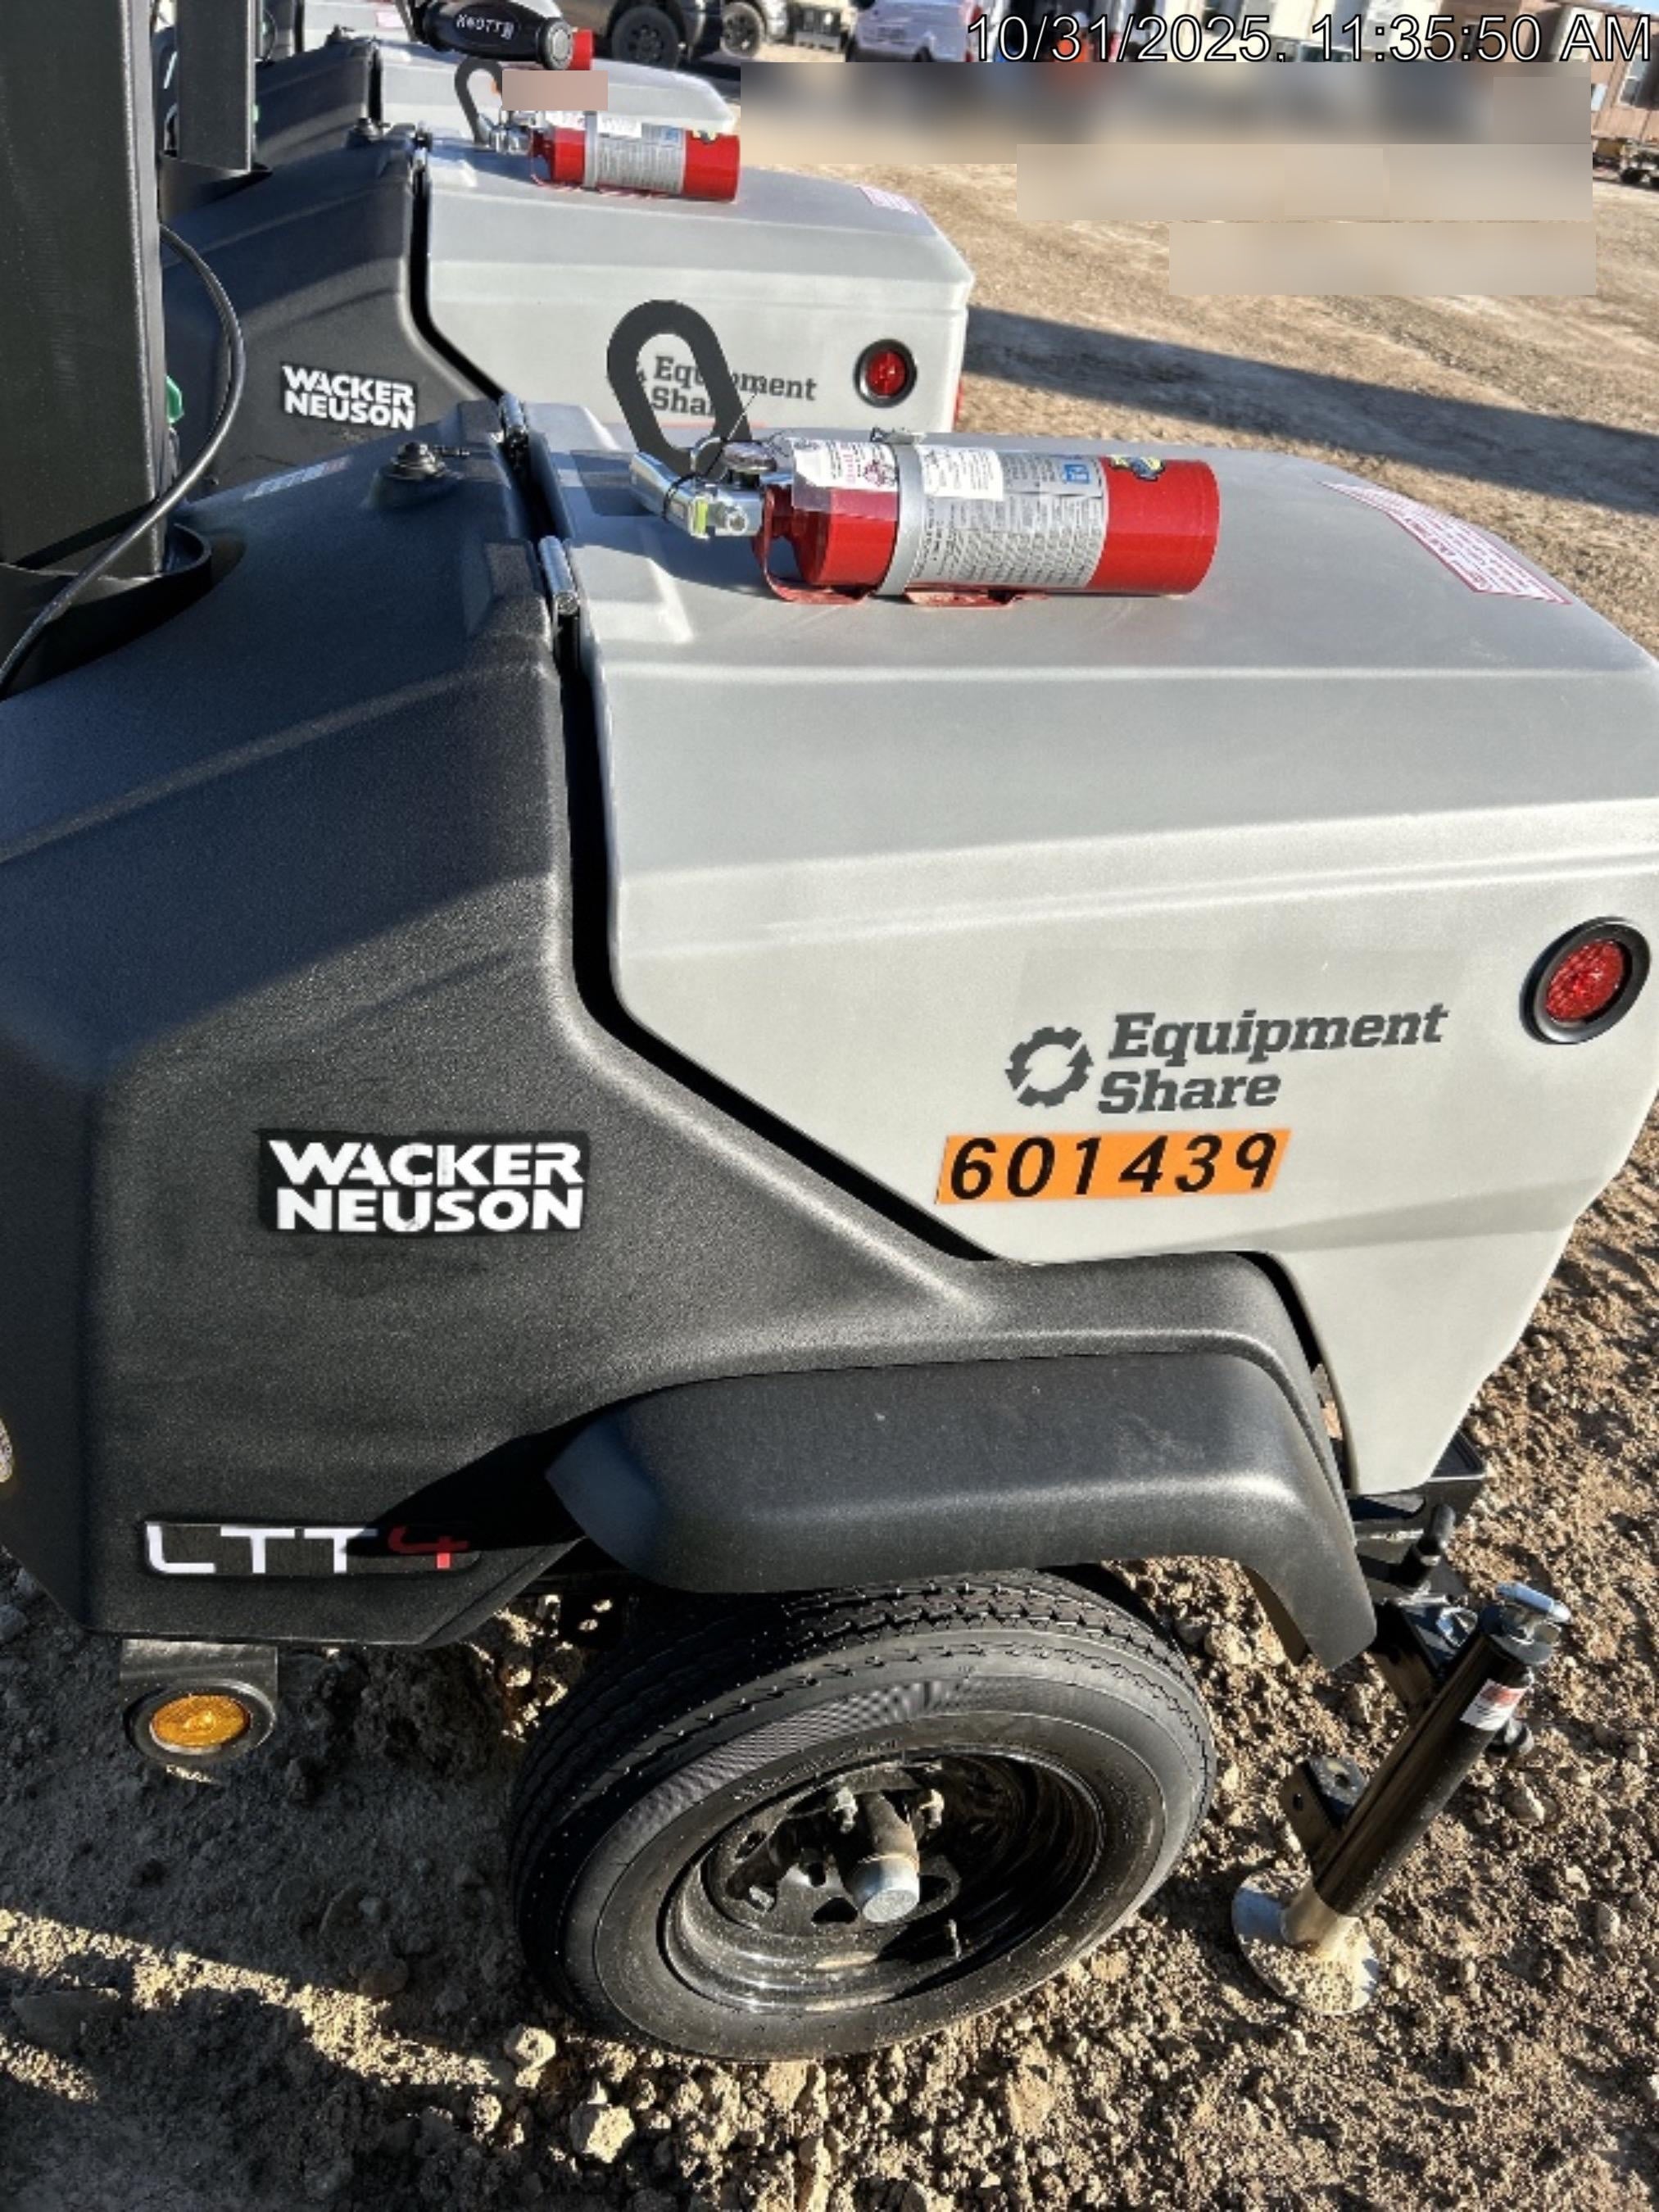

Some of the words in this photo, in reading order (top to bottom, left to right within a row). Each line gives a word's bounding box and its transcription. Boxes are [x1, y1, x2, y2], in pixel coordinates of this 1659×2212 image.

[282, 365, 415, 407] WACKER
[650, 385, 715, 417] Sha
[655, 356, 818, 401] Eqment
[284, 389, 415, 431] NEUSON
[1108, 1004, 1449, 1067] Equipment
[1097, 1068, 1281, 1114] Share
[269, 1140, 585, 1187] WACKER
[950, 1133, 1277, 1200] 601439
[277, 1187, 584, 1232] NEUSON
